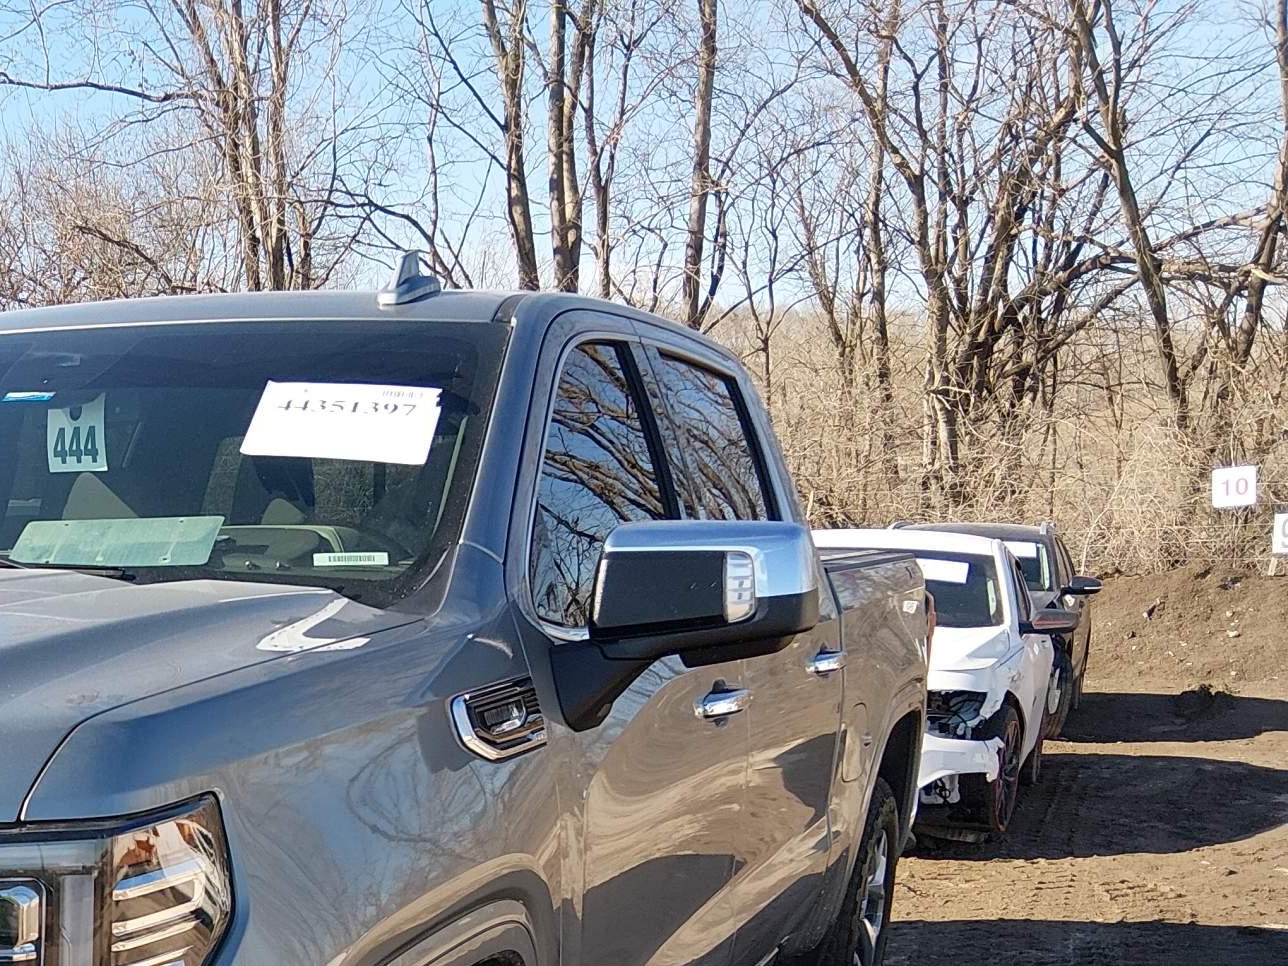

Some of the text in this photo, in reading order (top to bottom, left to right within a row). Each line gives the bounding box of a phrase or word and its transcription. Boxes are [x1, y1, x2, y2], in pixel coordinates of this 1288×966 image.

[277, 399, 417, 416] 44351397
[53, 425, 99, 465] 444
[1221, 477, 1249, 497] 10
